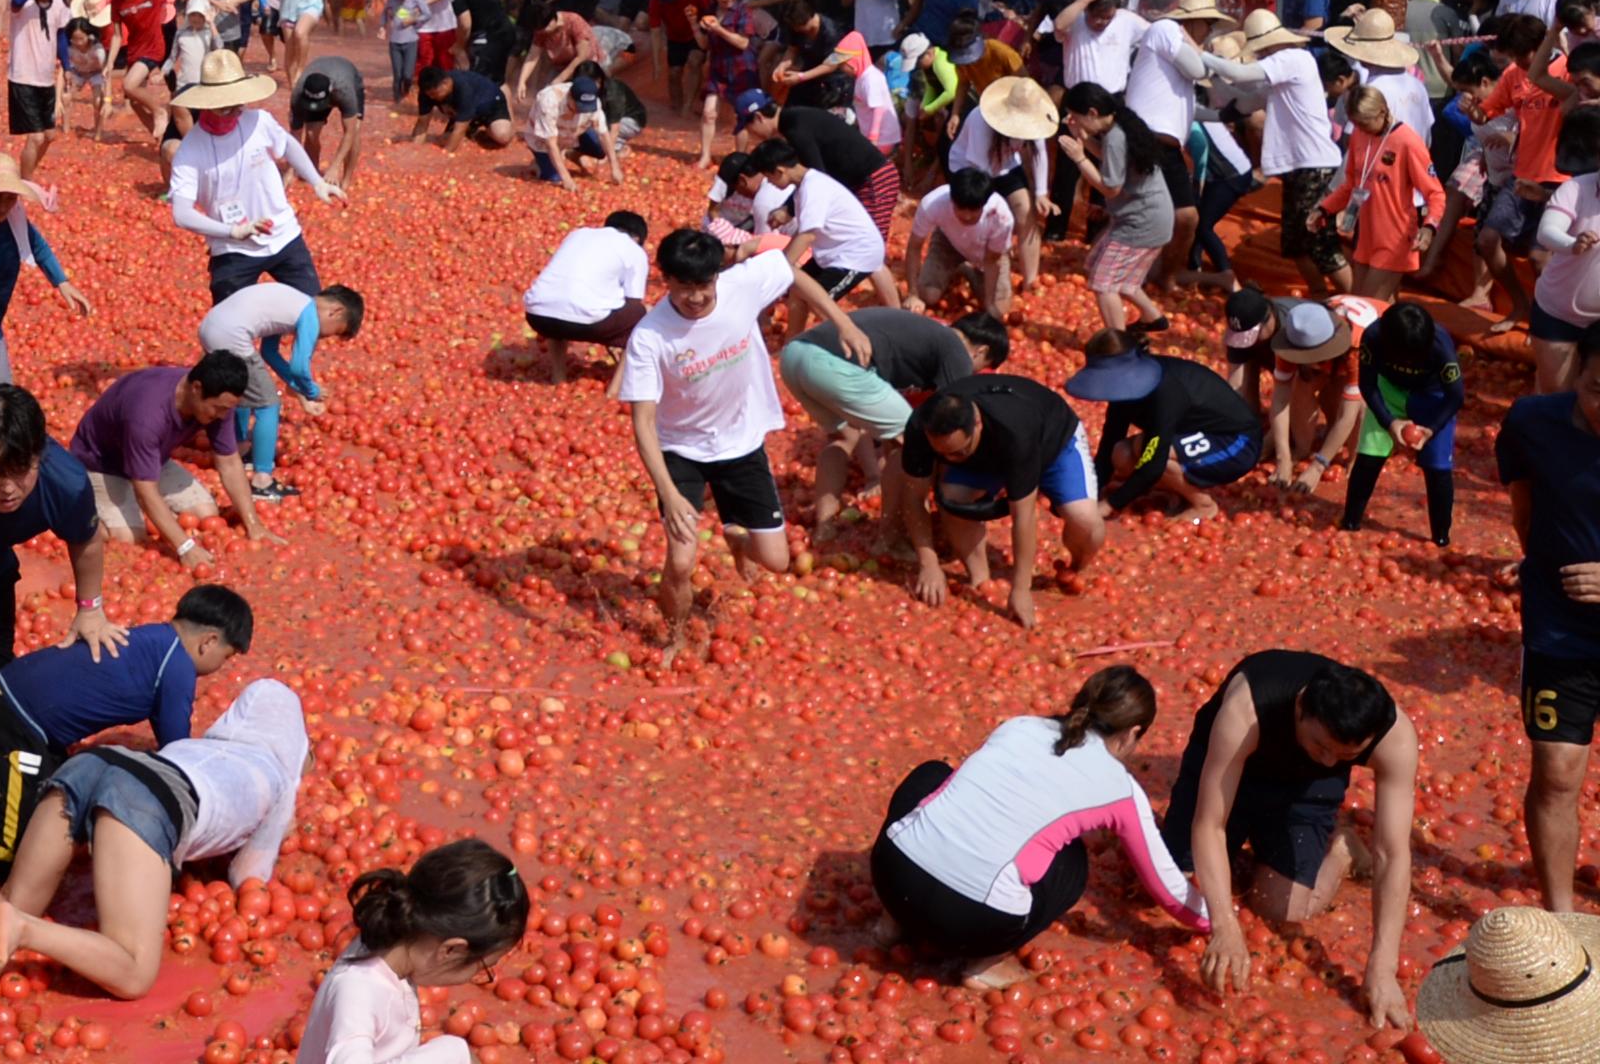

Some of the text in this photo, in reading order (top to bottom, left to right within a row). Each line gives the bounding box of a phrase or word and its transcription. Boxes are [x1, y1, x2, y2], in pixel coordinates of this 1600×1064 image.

[681, 338, 750, 377] 화천토마토축
[1180, 431, 1211, 457] 13
[1525, 686, 1558, 731] 16
